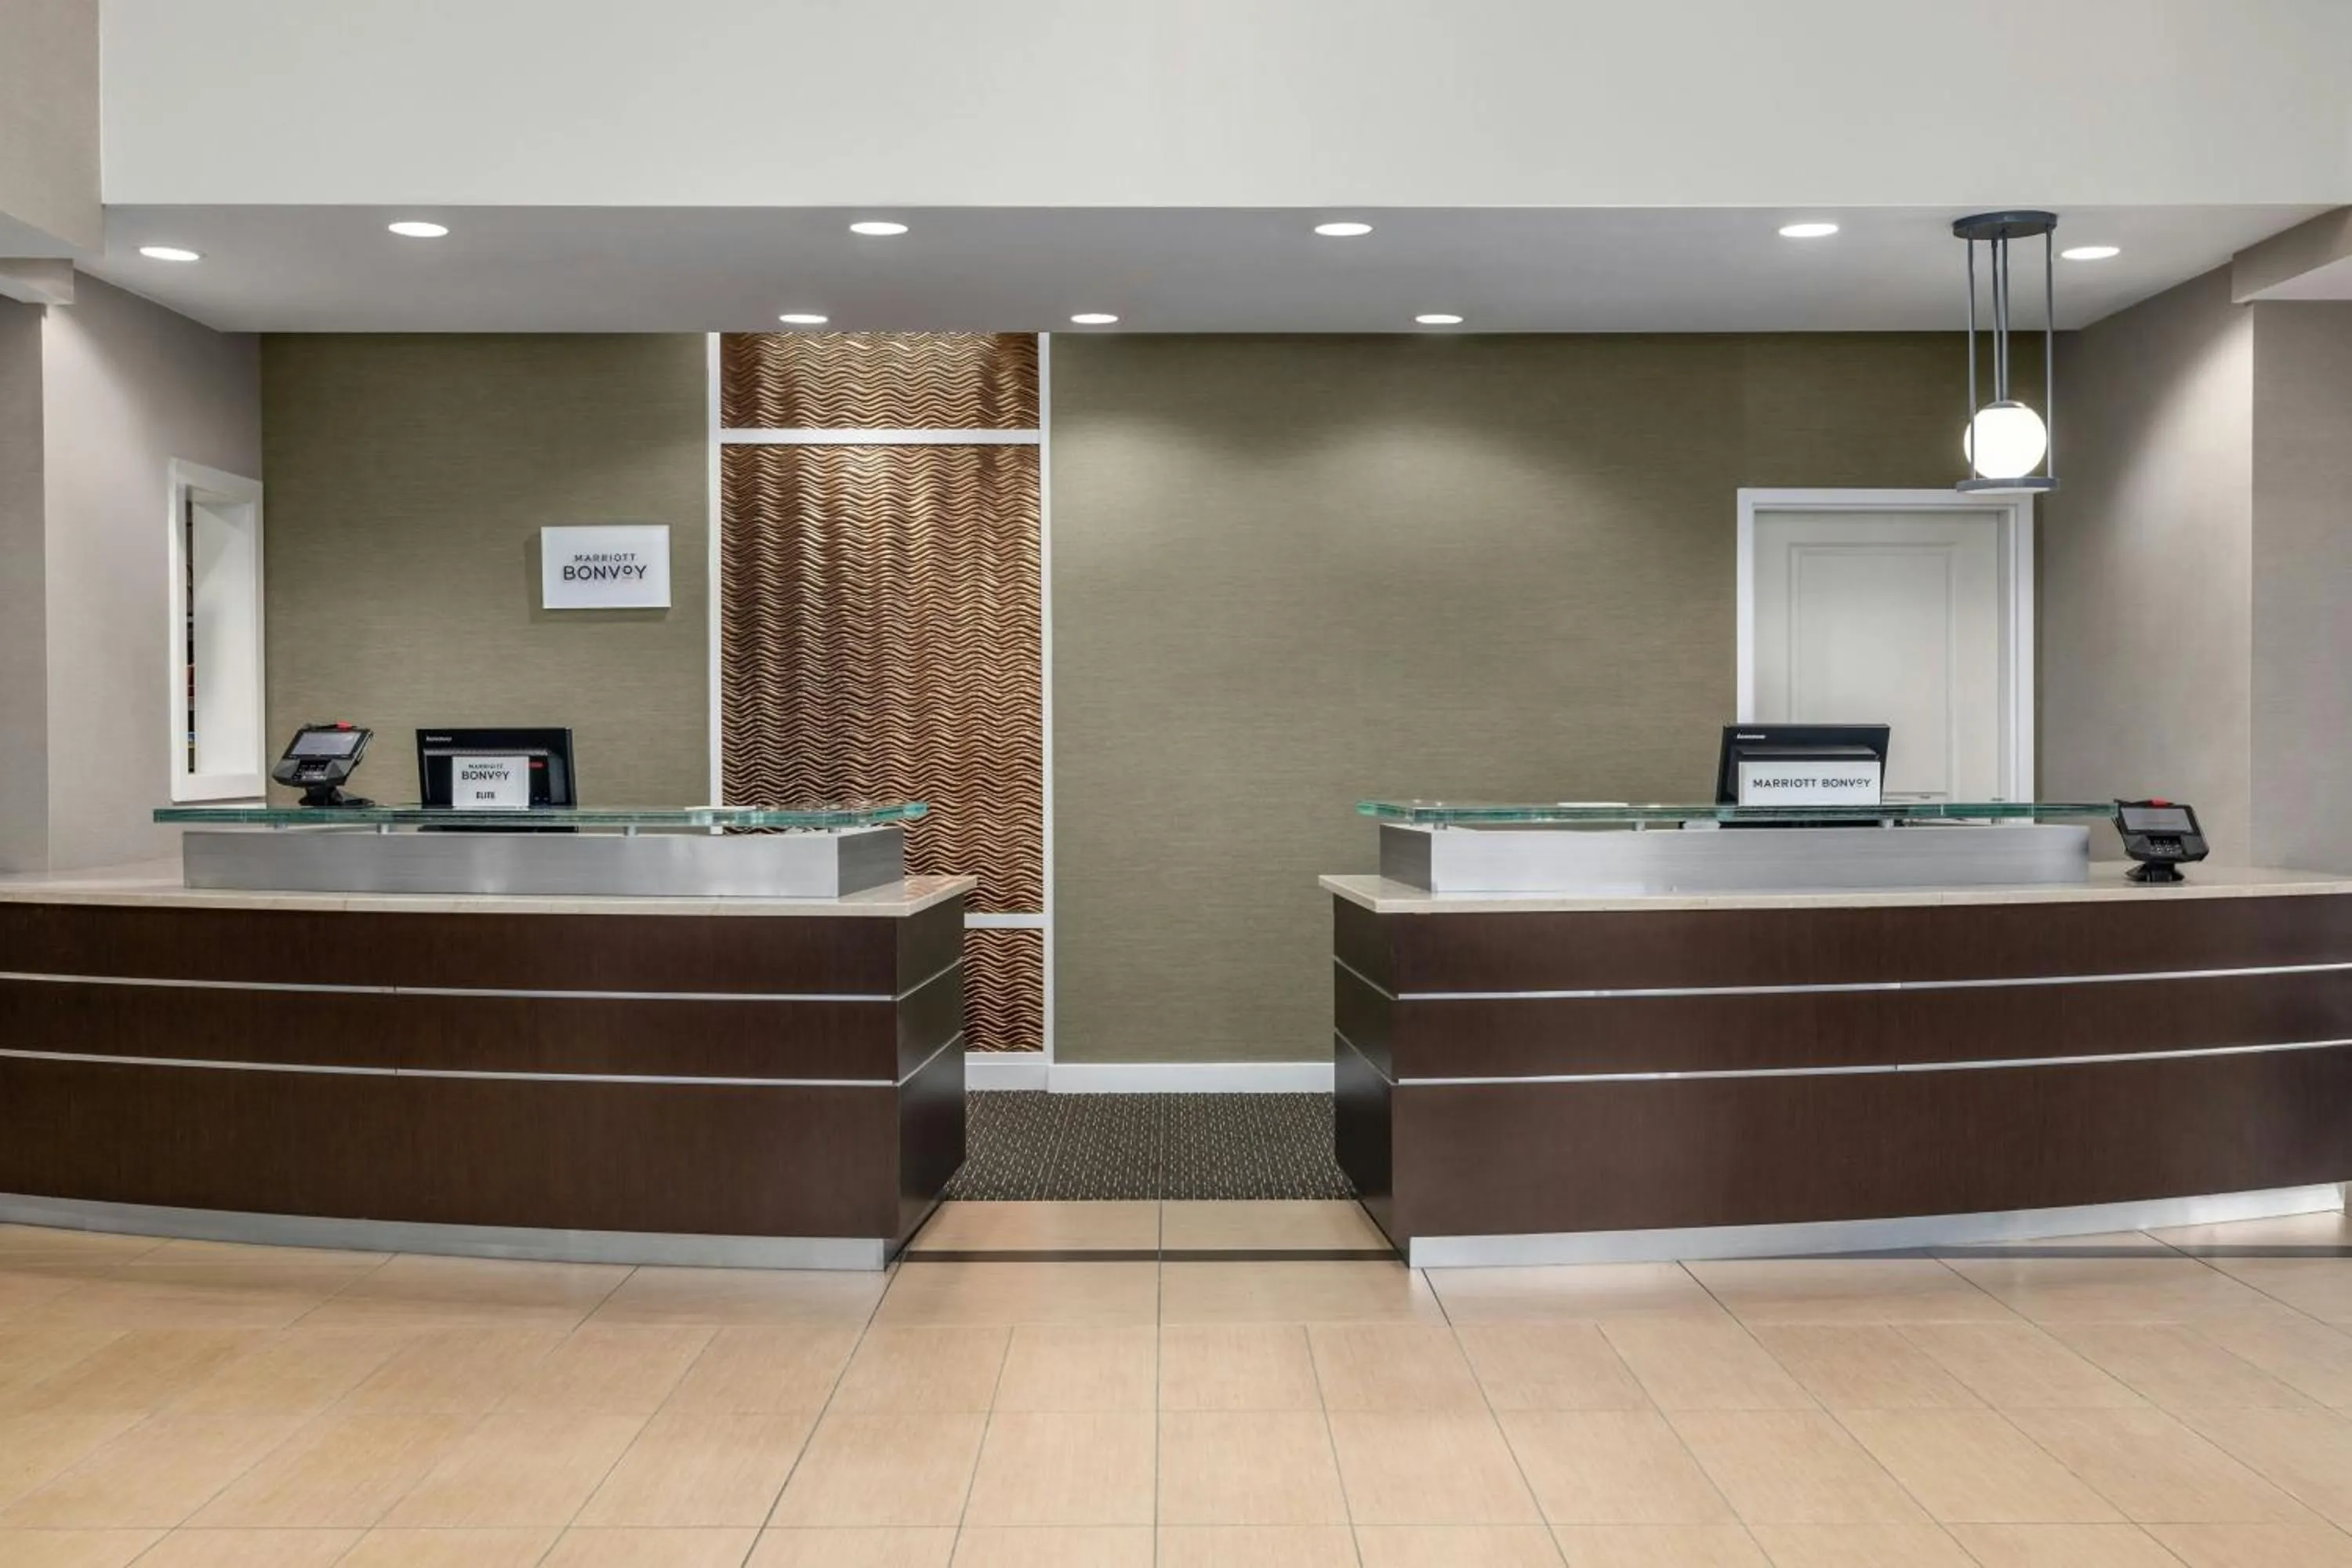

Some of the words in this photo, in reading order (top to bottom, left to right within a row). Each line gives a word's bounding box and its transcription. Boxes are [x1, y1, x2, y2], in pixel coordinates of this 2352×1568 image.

[574, 553, 636, 562] MARRIOTT
[1753, 779, 1817, 788] MARRIOTT
[476, 791, 495, 800] ELITE
